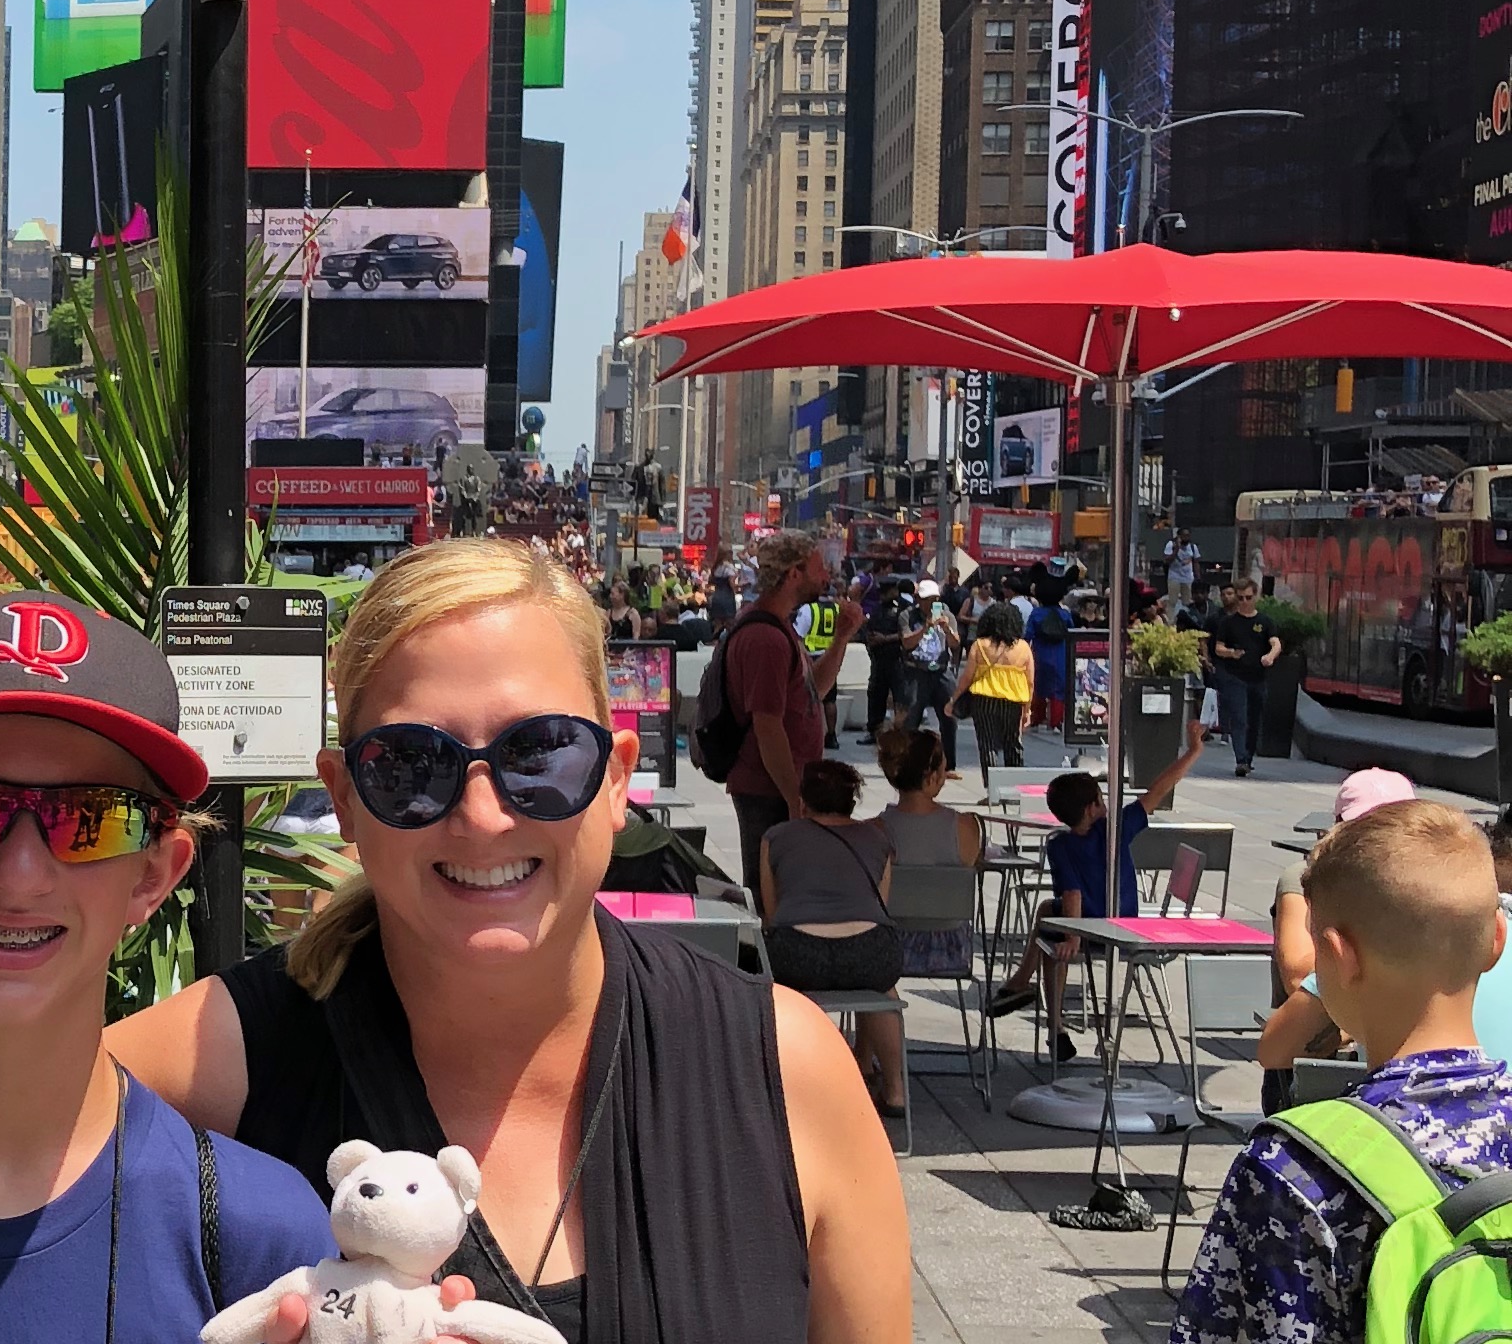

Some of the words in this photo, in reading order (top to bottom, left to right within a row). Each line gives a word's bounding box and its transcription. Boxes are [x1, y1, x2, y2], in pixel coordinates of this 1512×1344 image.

[1475, 179, 1501, 207] FINAL
[255, 479, 331, 494] COFFEED
[339, 479, 370, 494] SWEET
[374, 479, 420, 494] CHURROS
[688, 492, 711, 541] tkts
[167, 600, 194, 610] Times
[196, 600, 230, 612] Square
[301, 599, 323, 610] NYC
[167, 612, 214, 623] Pedestrian
[216, 612, 241, 622] Plaza
[167, 634, 191, 645] Plaza
[193, 634, 233, 645] Peatonal
[177, 665, 241, 676] DESIGNATED
[177, 680, 221, 691] ACTIVITY
[225, 680, 256, 691] ZONE
[178, 705, 205, 716] ZONA
[207, 705, 220, 716] DE
[224, 705, 283, 716] ACTIVIDAD
[178, 720, 236, 731] DESIGNADA
[320, 1288, 357, 1320] 24
